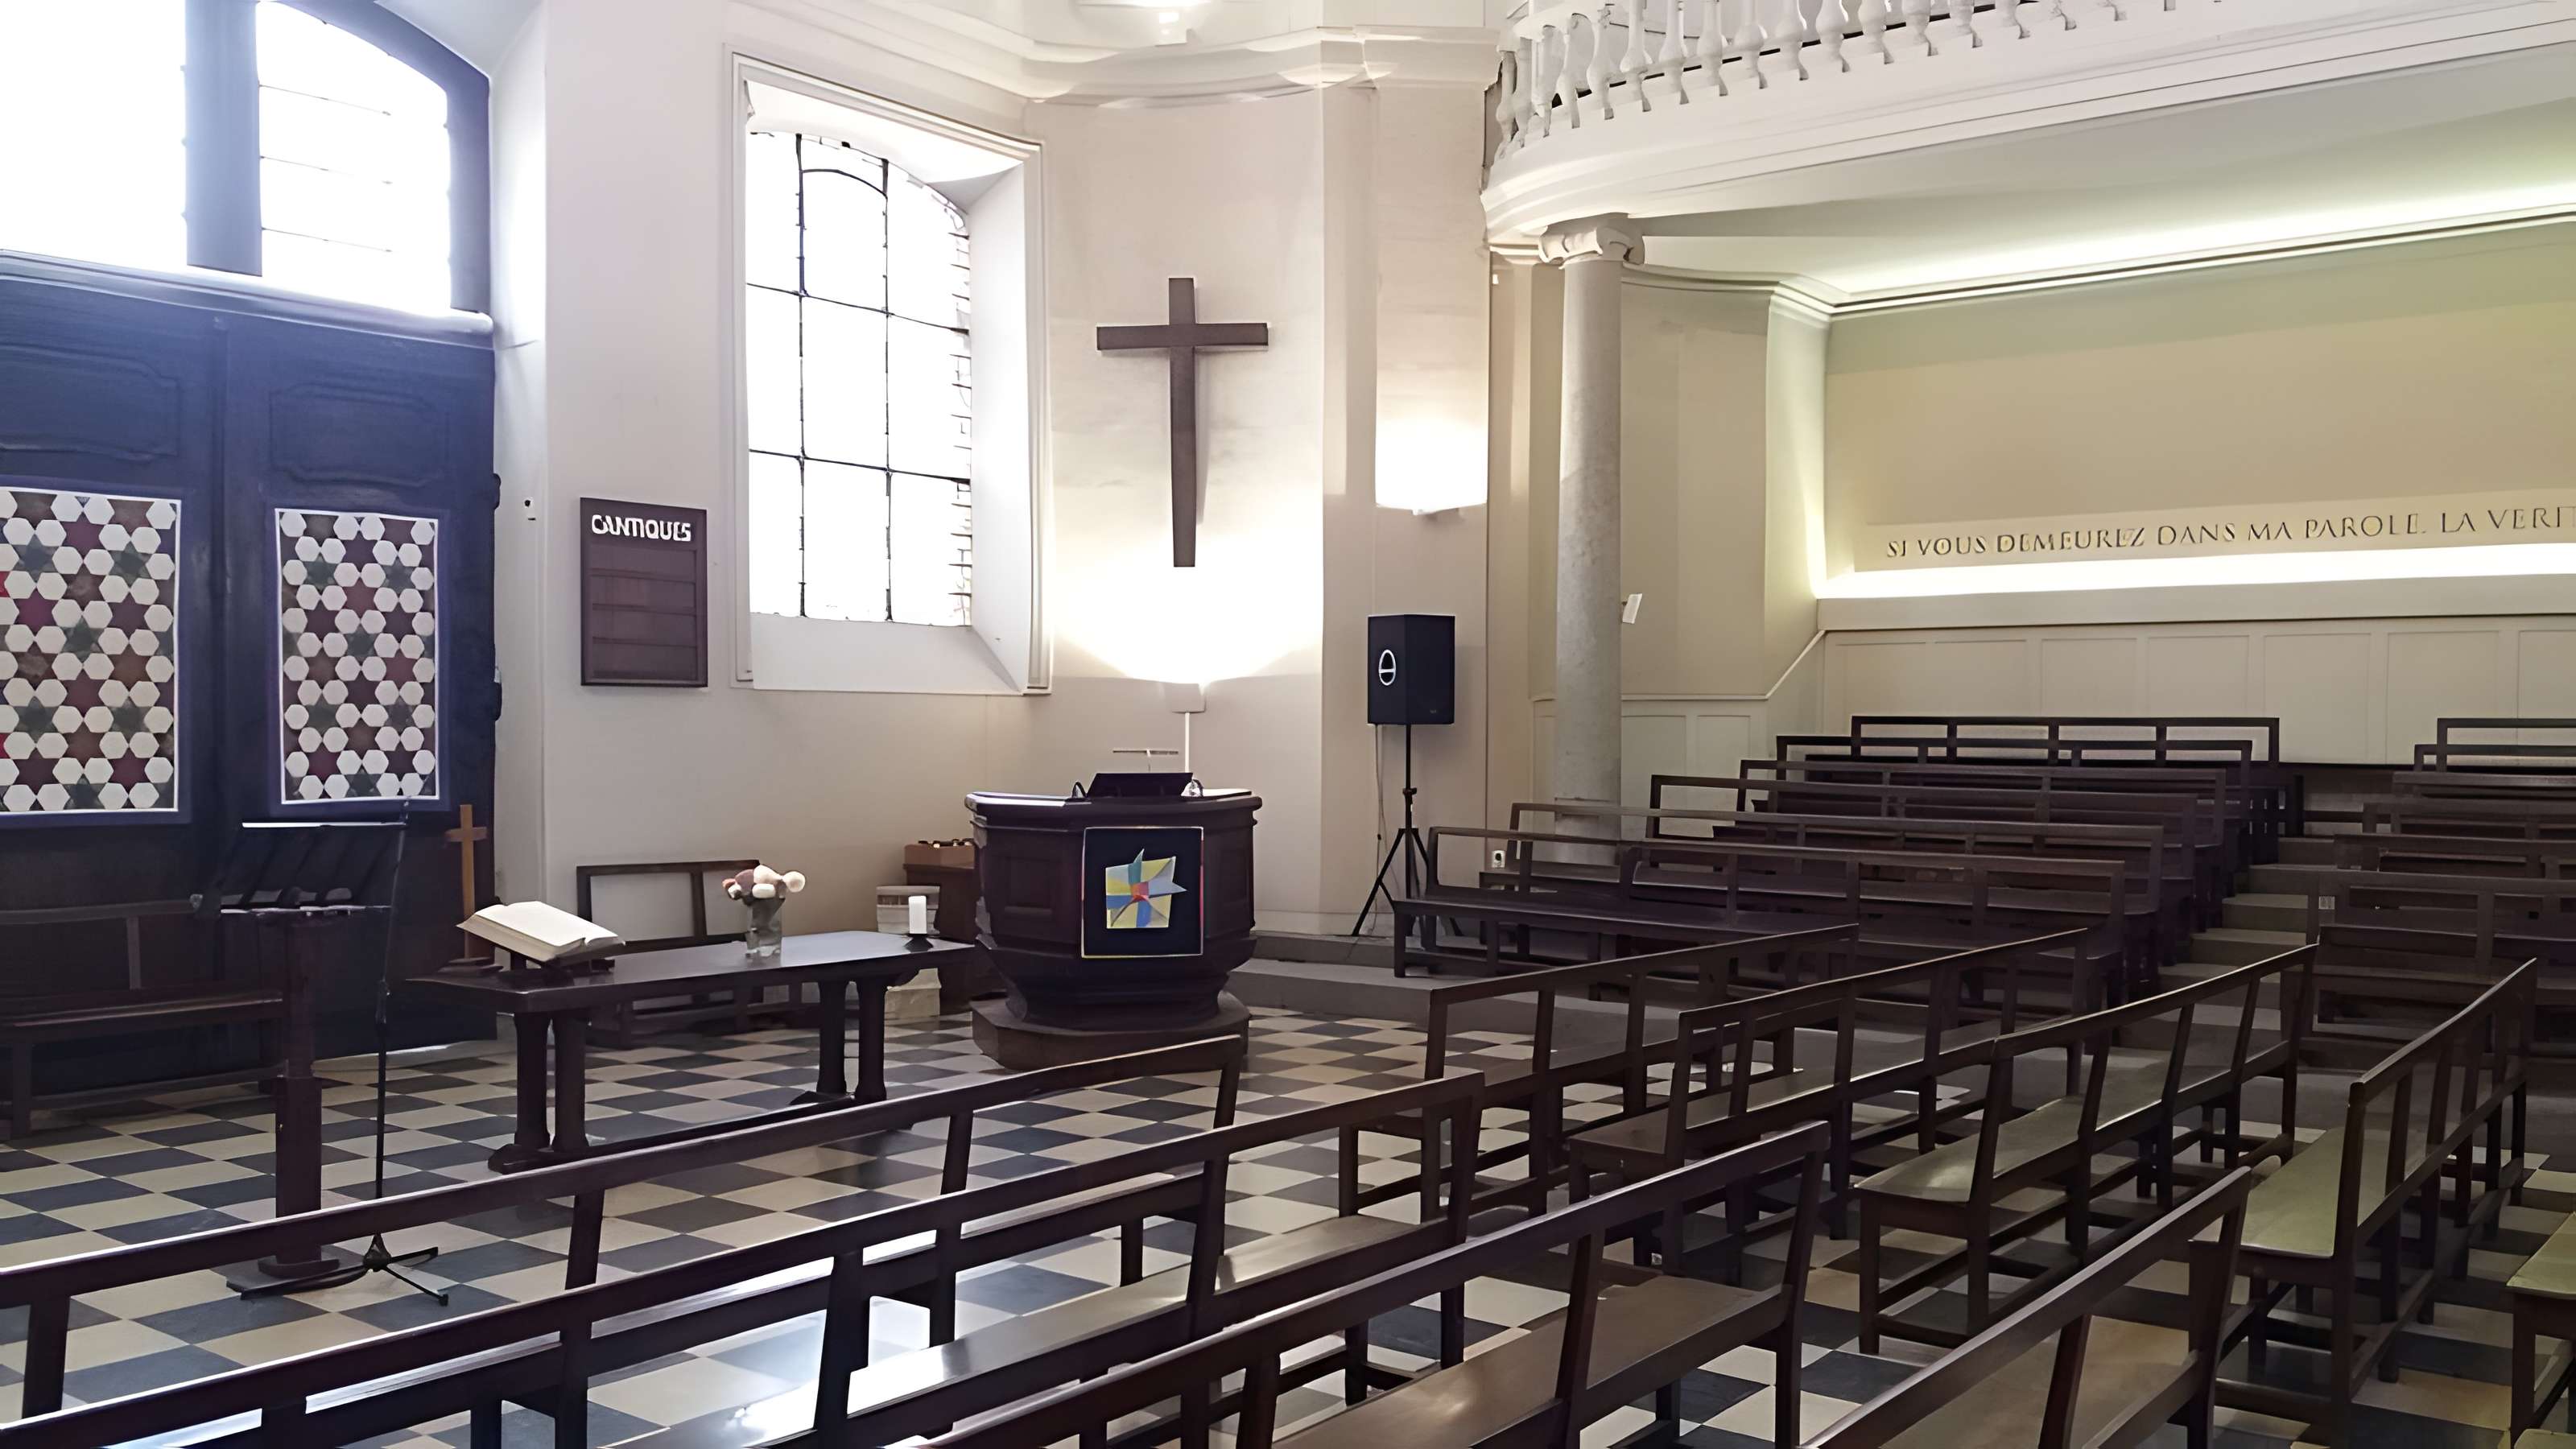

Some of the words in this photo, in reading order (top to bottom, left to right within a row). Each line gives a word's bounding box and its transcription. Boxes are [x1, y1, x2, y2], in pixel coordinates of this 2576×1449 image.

[592, 514, 691, 542] CANTIQUES
[1886, 540, 1906, 557] SI
[1917, 535, 1988, 555] VOUS
[1996, 527, 2145, 553] DEMEUREZ
[2157, 523, 2235, 546] DANS
[2248, 522, 2292, 542] MA
[2442, 512, 2476, 533] LA
